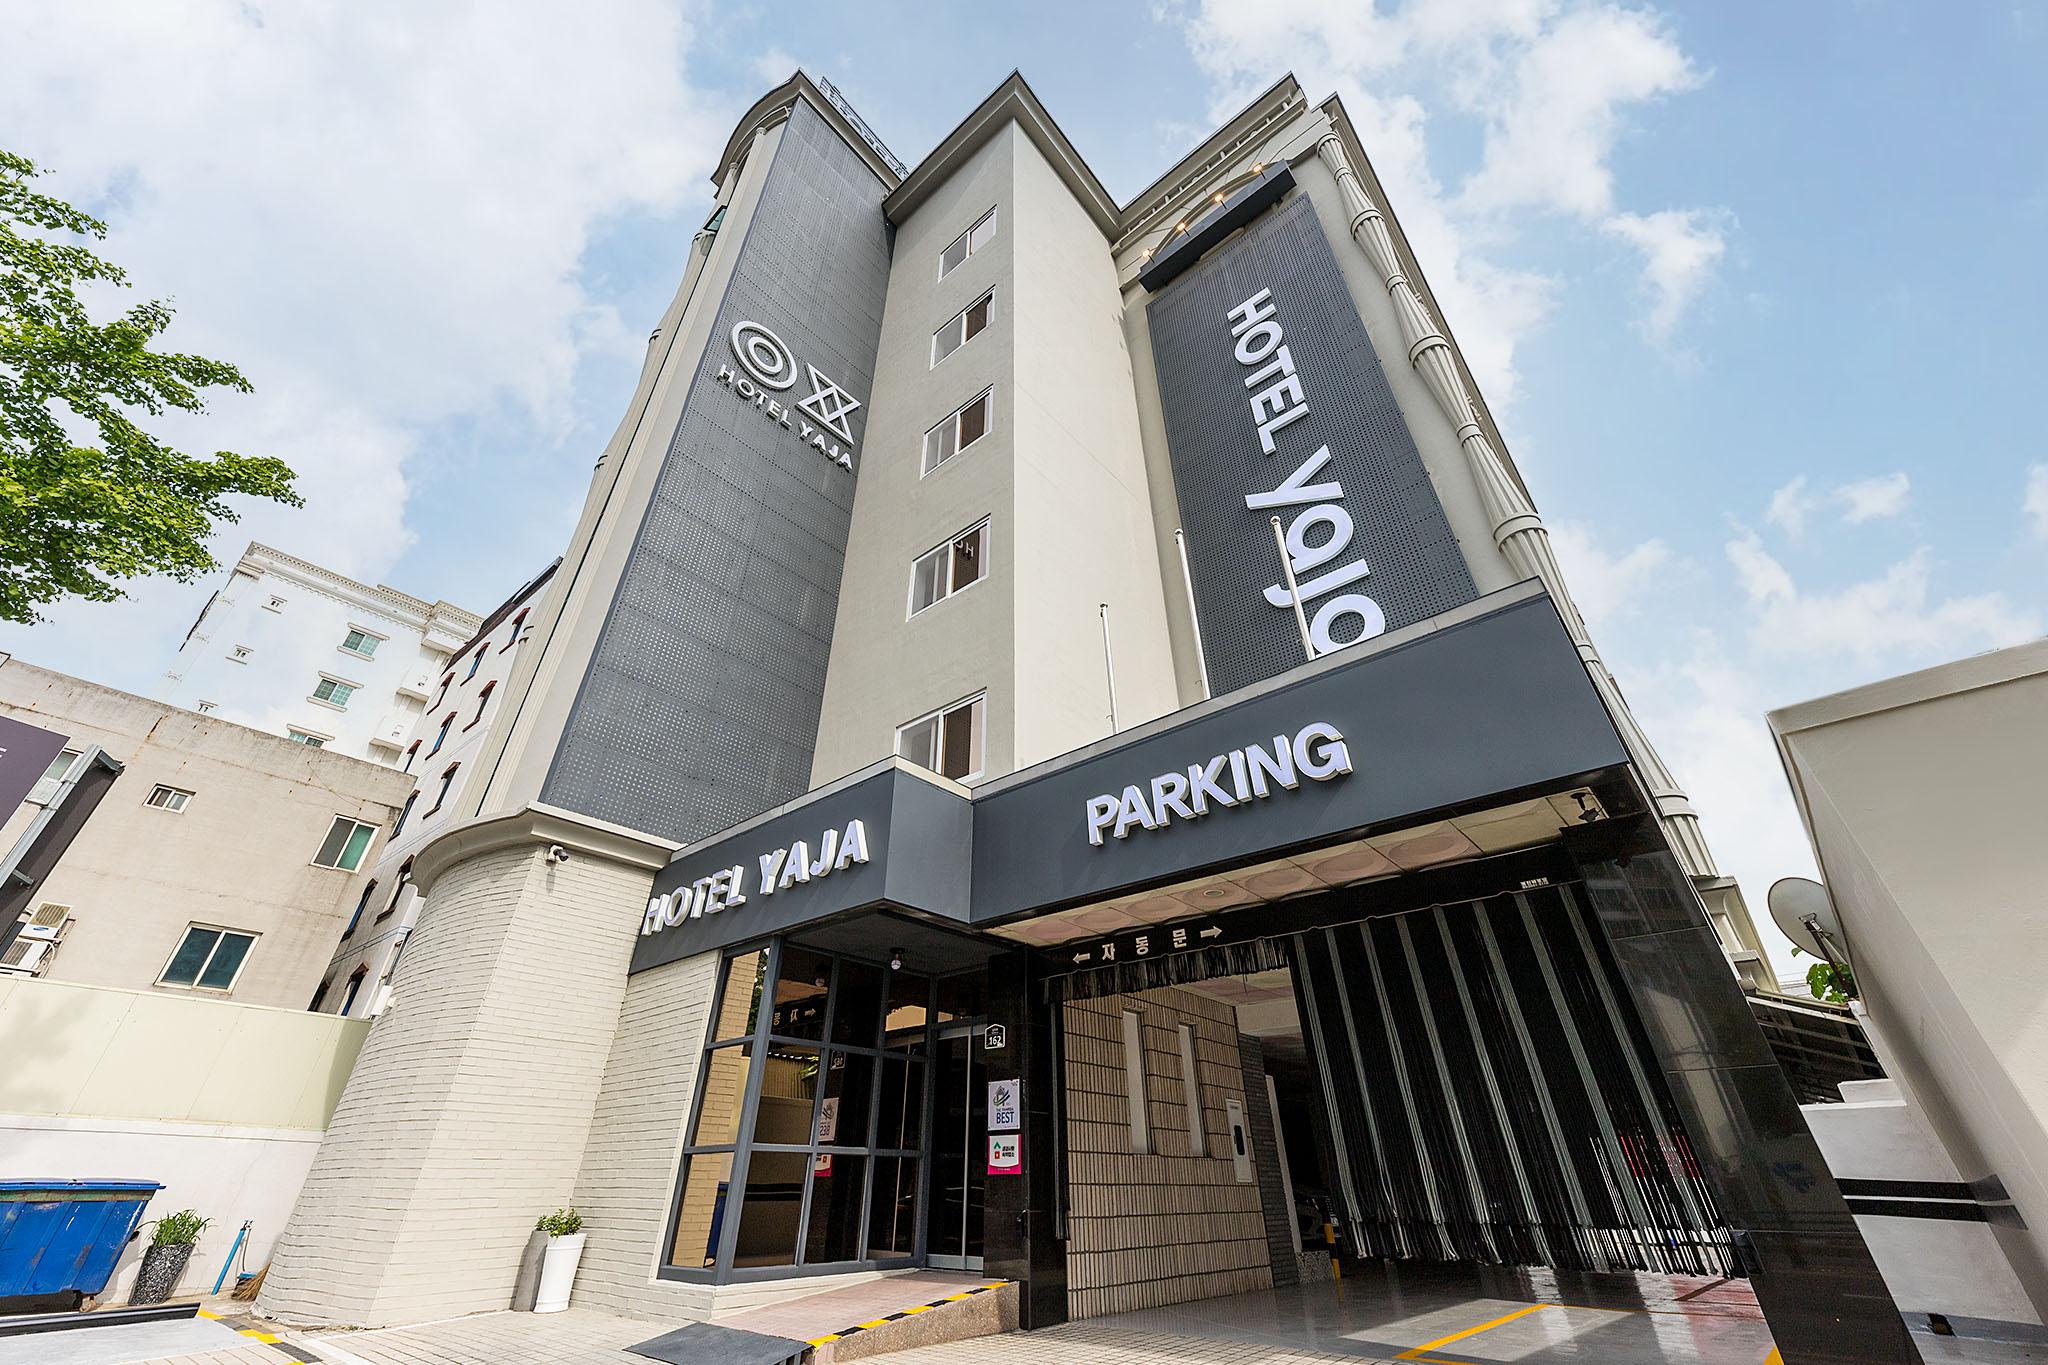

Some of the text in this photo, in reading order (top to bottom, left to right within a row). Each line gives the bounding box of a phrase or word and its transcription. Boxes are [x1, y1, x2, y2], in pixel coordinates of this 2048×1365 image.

[718, 363, 853, 471] HOTEL YAJA
[1227, 287, 1309, 456] HOTEL
[1086, 722, 1353, 846] PARKING
[641, 819, 870, 936] HOTEL YAJA
[989, 1035, 1002, 1046] 162
[996, 1111, 1015, 1124] BEST
